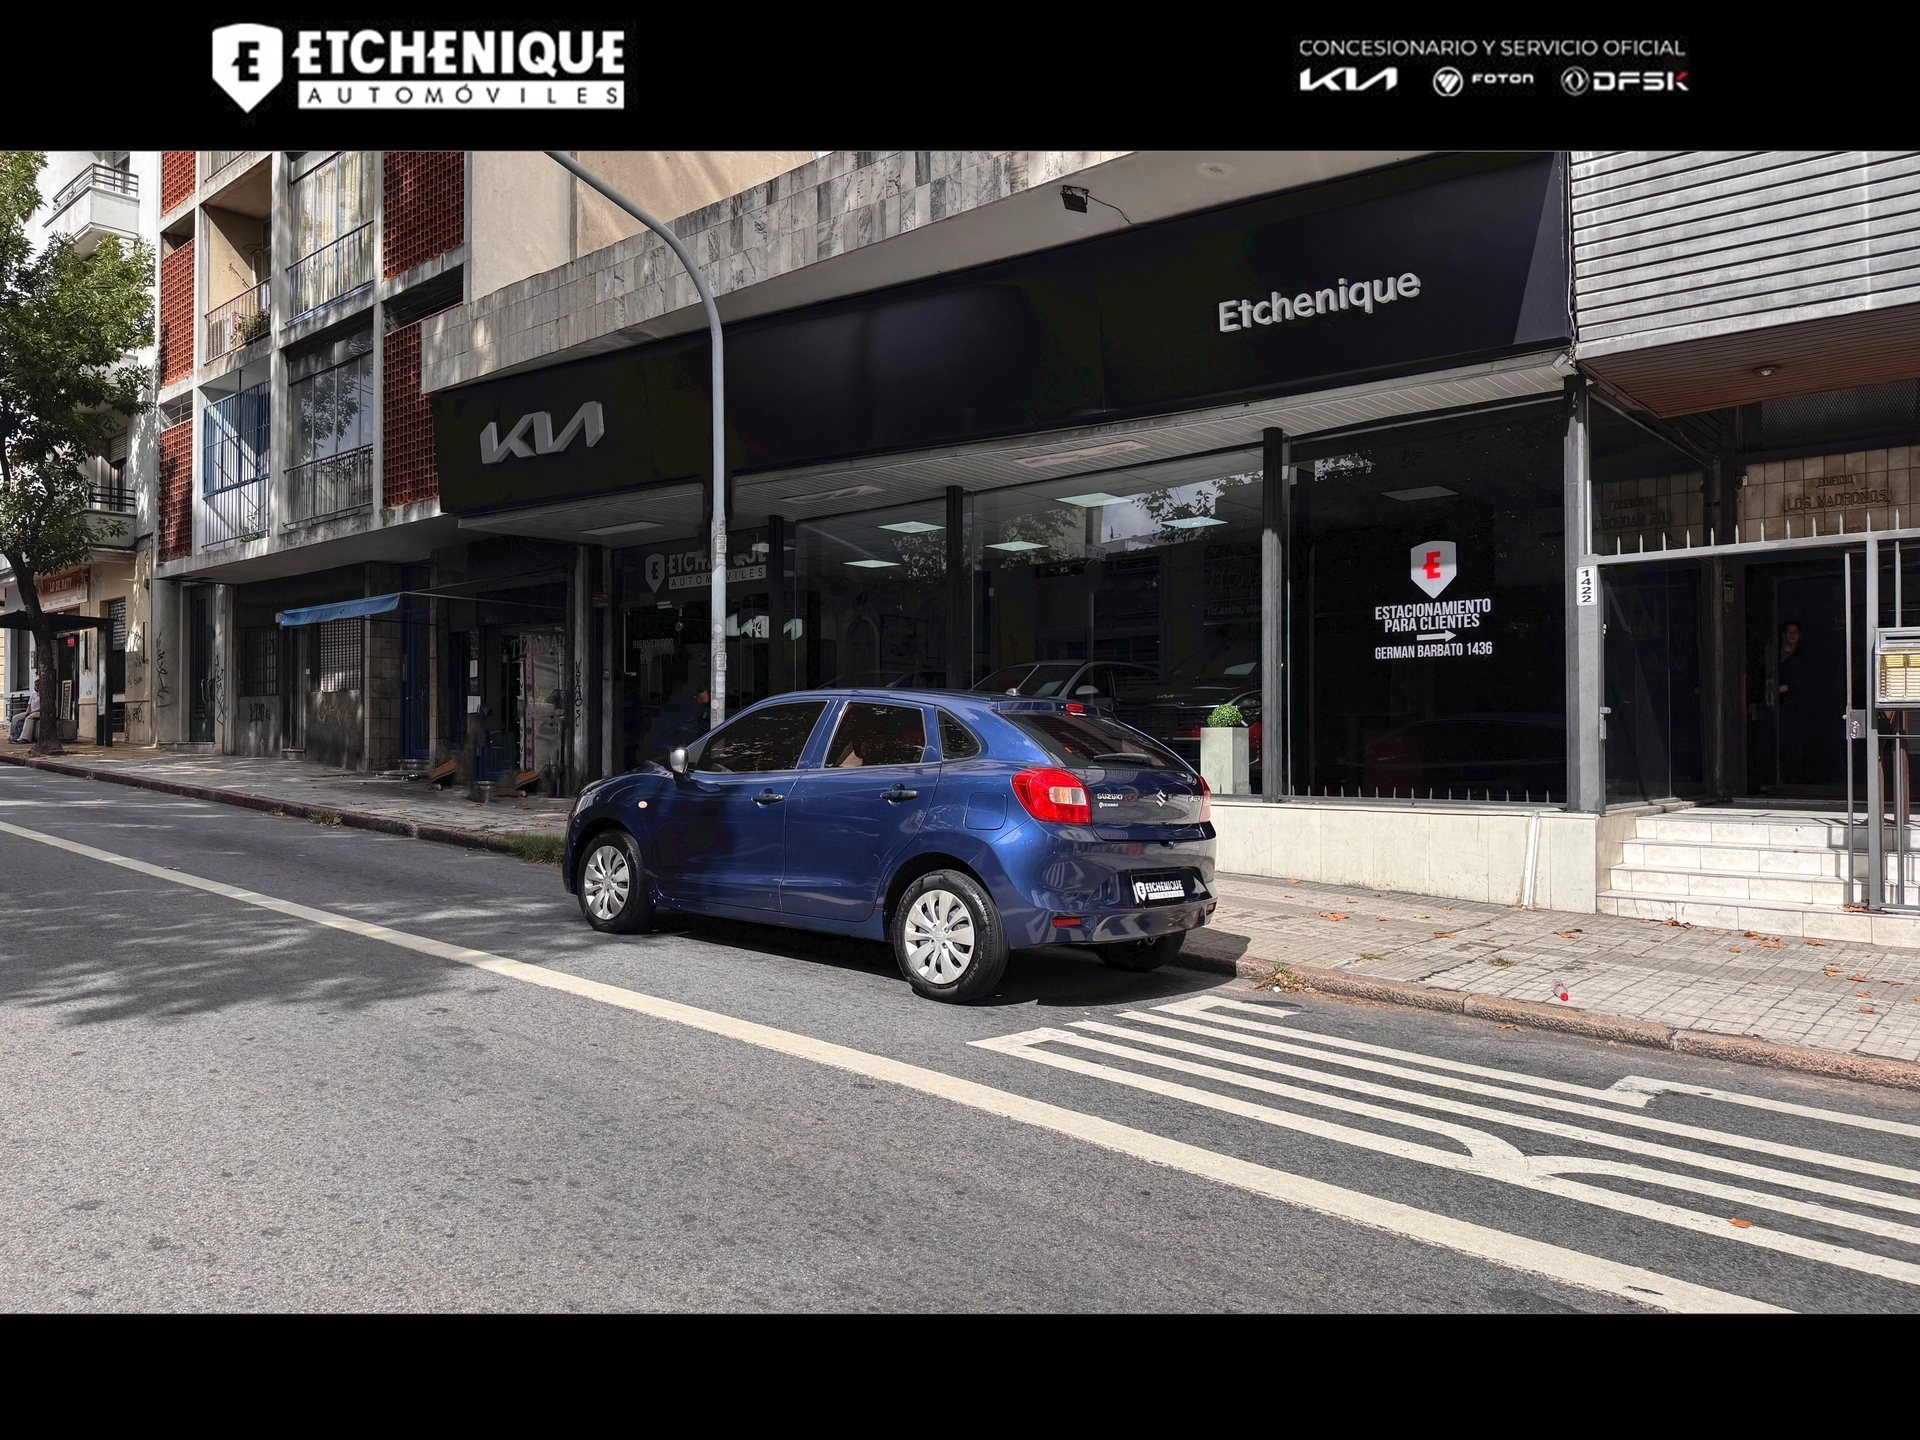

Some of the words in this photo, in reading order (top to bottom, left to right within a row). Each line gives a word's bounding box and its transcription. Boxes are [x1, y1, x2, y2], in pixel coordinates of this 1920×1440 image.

[1218, 272, 1421, 333] Etchenique
[480, 401, 605, 465] KIA
[1785, 497, 1811, 511] LOS
[667, 551, 767, 575] ETCHQUE
[671, 566, 763, 588] AUTOMVILES
[1581, 569, 1592, 602] 1422
[1375, 598, 1491, 620] ESTACIONAMIENTO
[1384, 618, 1417, 633] PARA
[1420, 613, 1480, 631] CLIENTES
[1375, 645, 1415, 660] GERMAN
[1417, 643, 1463, 658] BARBATO
[1467, 641, 1493, 656] 1436
[1145, 880, 1183, 892] ETCHENIQUE
